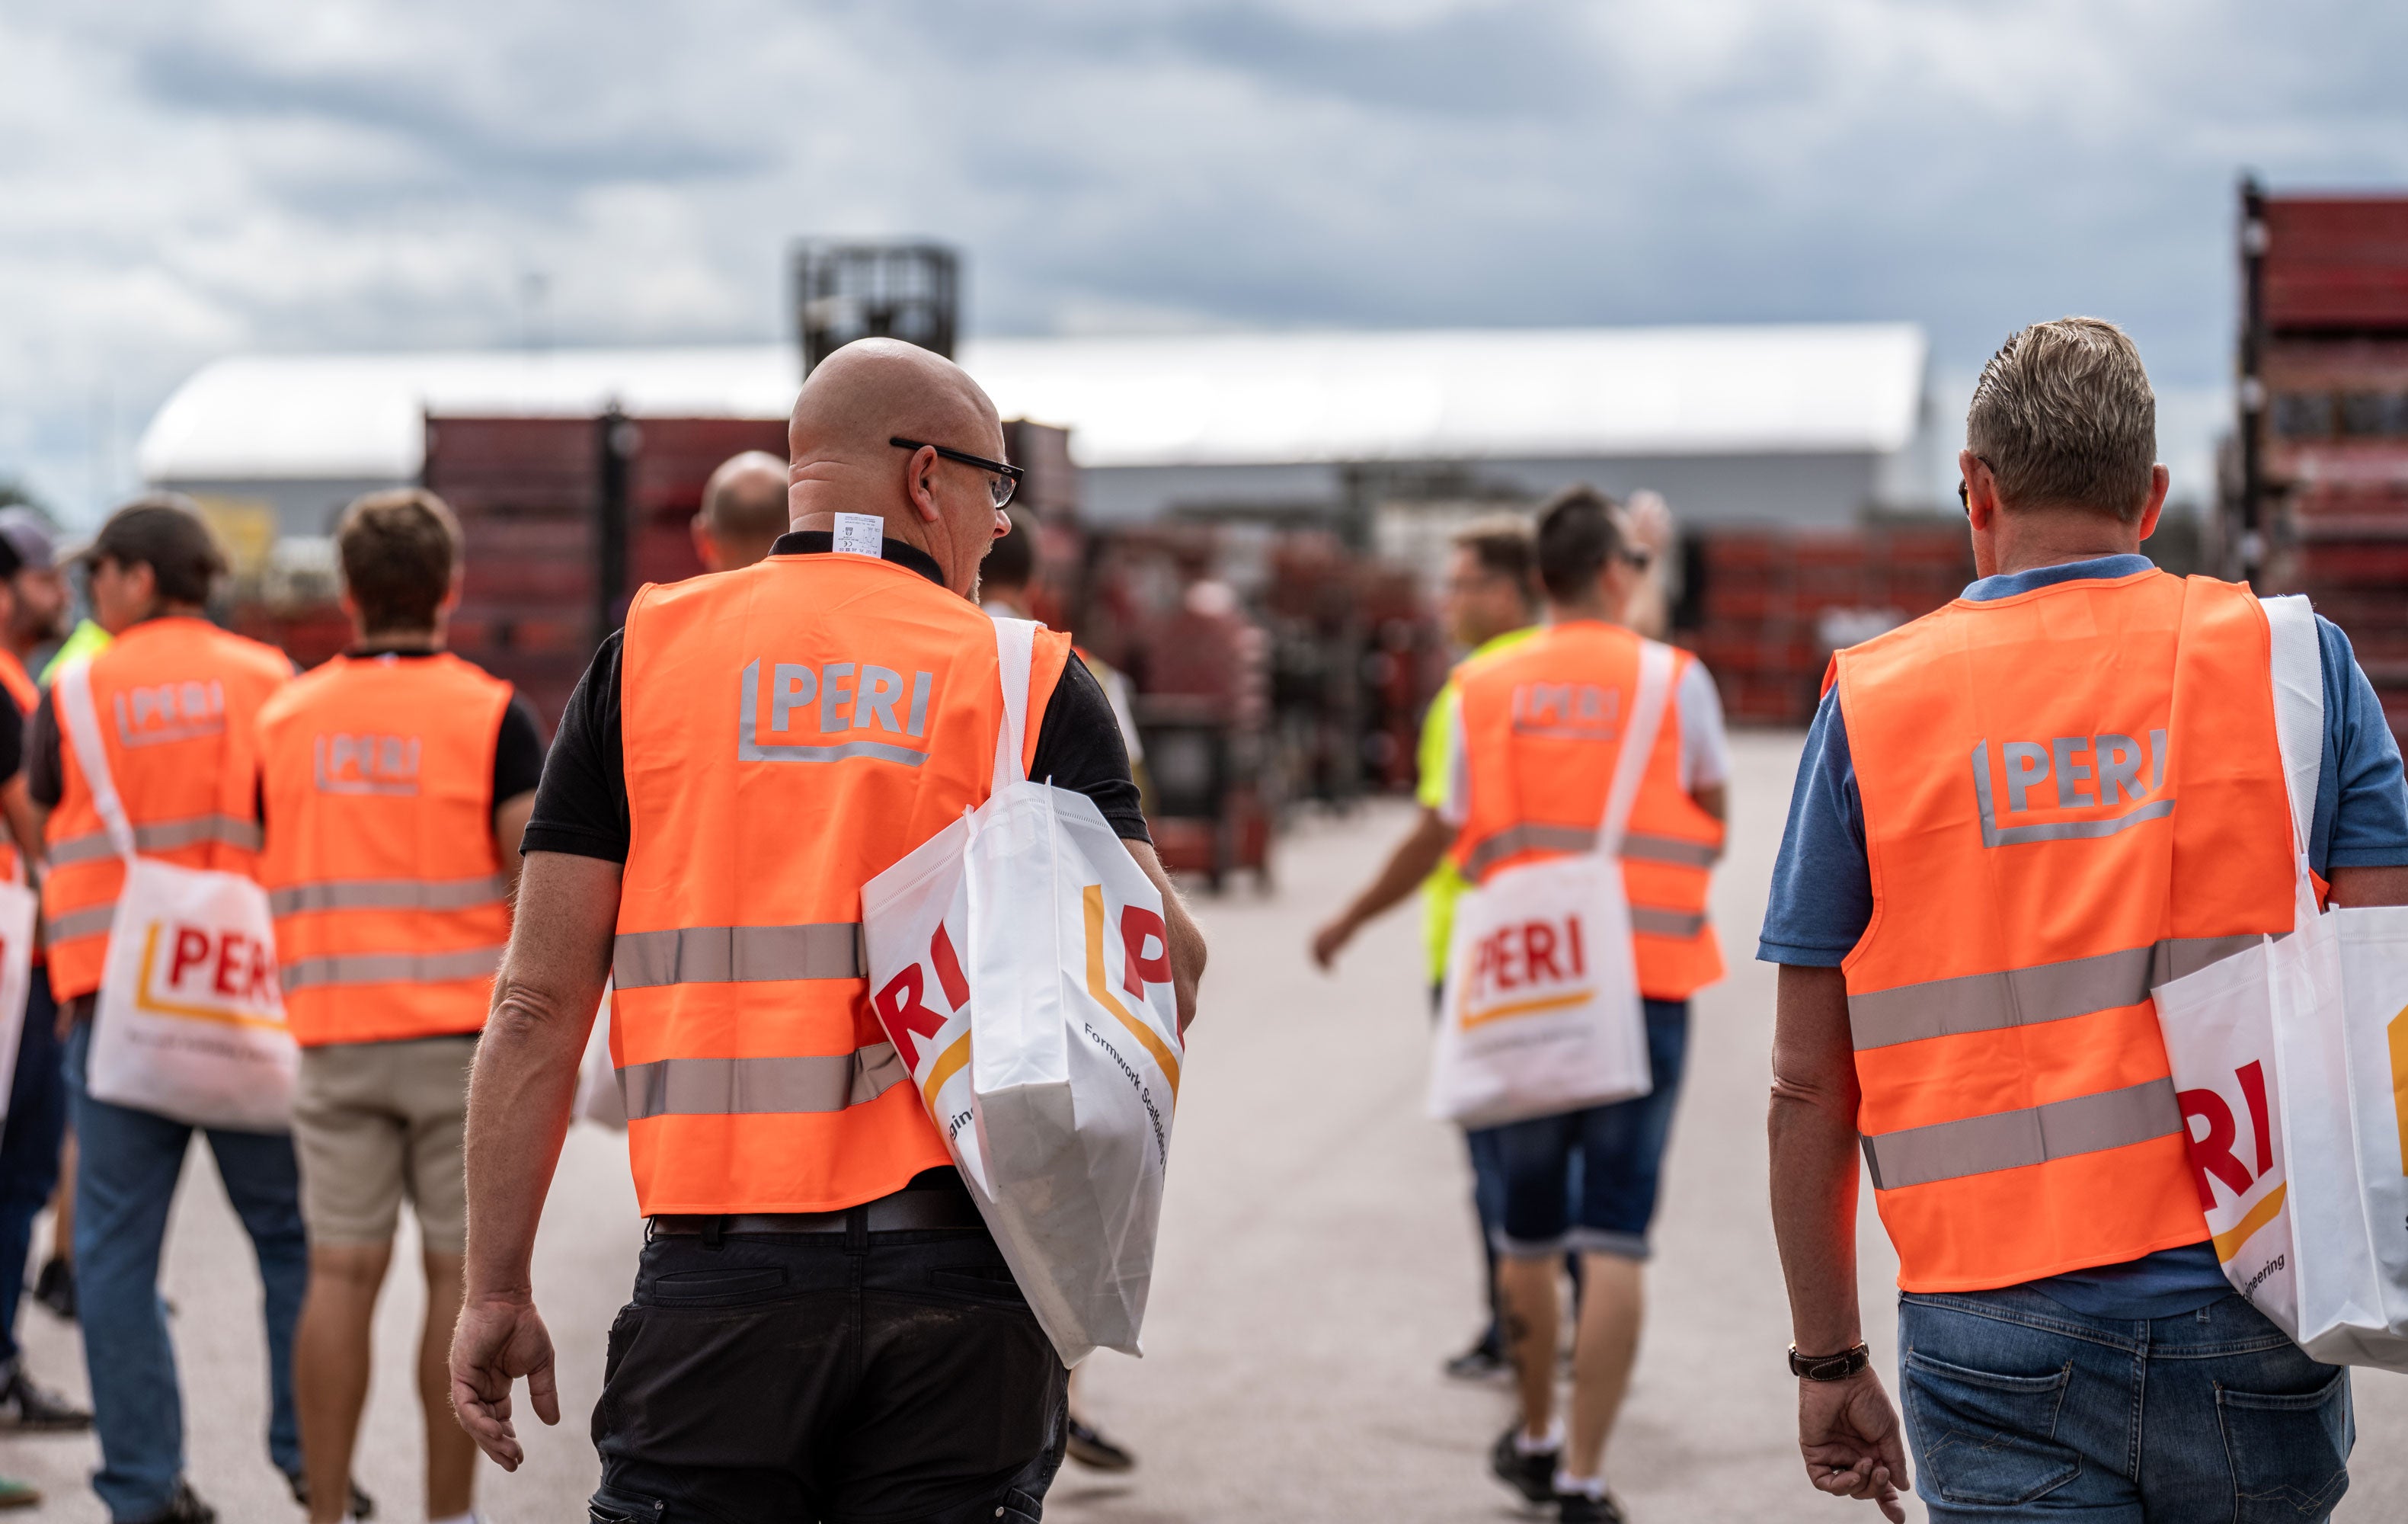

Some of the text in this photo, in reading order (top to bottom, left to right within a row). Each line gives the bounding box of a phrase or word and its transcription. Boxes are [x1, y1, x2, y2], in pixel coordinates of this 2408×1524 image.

[771, 662, 933, 738] PERI
[2002, 728, 2167, 813] PERI
[1084, 1022, 1166, 1165] Formwork Scaffolding
